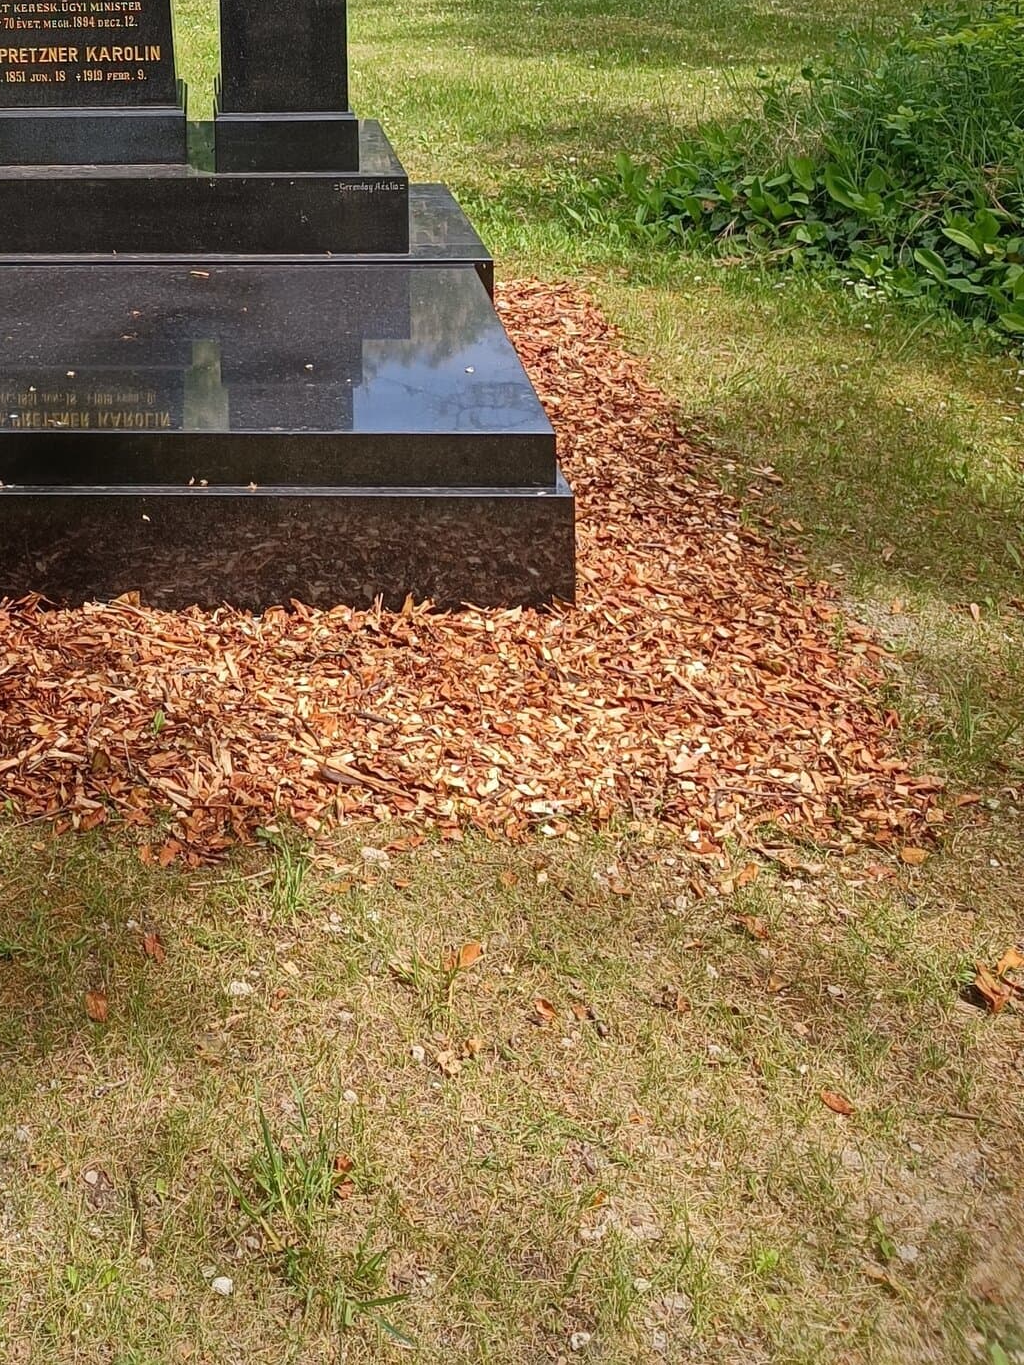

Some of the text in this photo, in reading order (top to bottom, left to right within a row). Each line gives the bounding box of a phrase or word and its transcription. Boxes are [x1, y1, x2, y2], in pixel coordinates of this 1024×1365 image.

[90, 1, 142, 12] MINISTER
[3, 17, 16, 29] 70
[72, 15, 96, 28] 1894
[86, 45, 162, 62] KAROLIN
[5, 70, 26, 83] 1851
